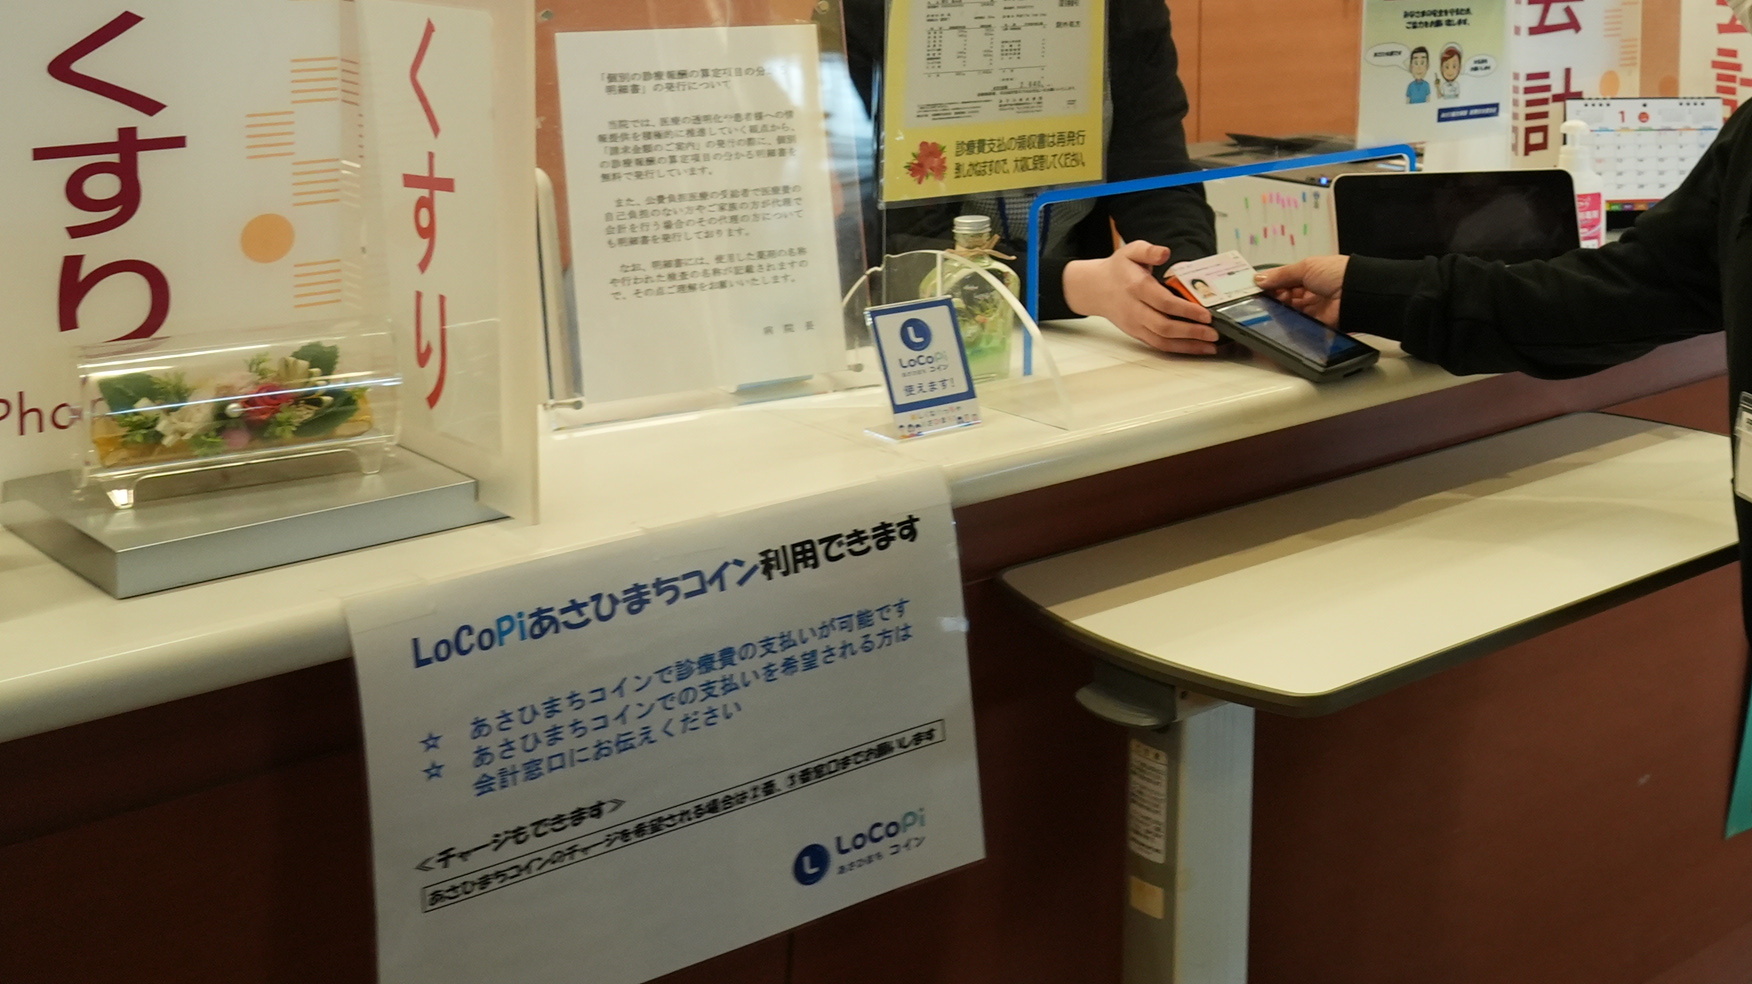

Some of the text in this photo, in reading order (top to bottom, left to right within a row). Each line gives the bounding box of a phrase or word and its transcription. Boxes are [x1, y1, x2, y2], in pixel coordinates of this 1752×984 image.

[32, 10, 187, 344] くすり
[403, 17, 455, 410] くすり
[470, 598, 911, 740] あさひまちコインで診療費の支払いが可能です
[472, 622, 913, 768] あさひまちコインでの支払いを希望される方は
[472, 701, 742, 798] 会計窓口にお伝えください
[834, 807, 926, 855] LoCoPi
